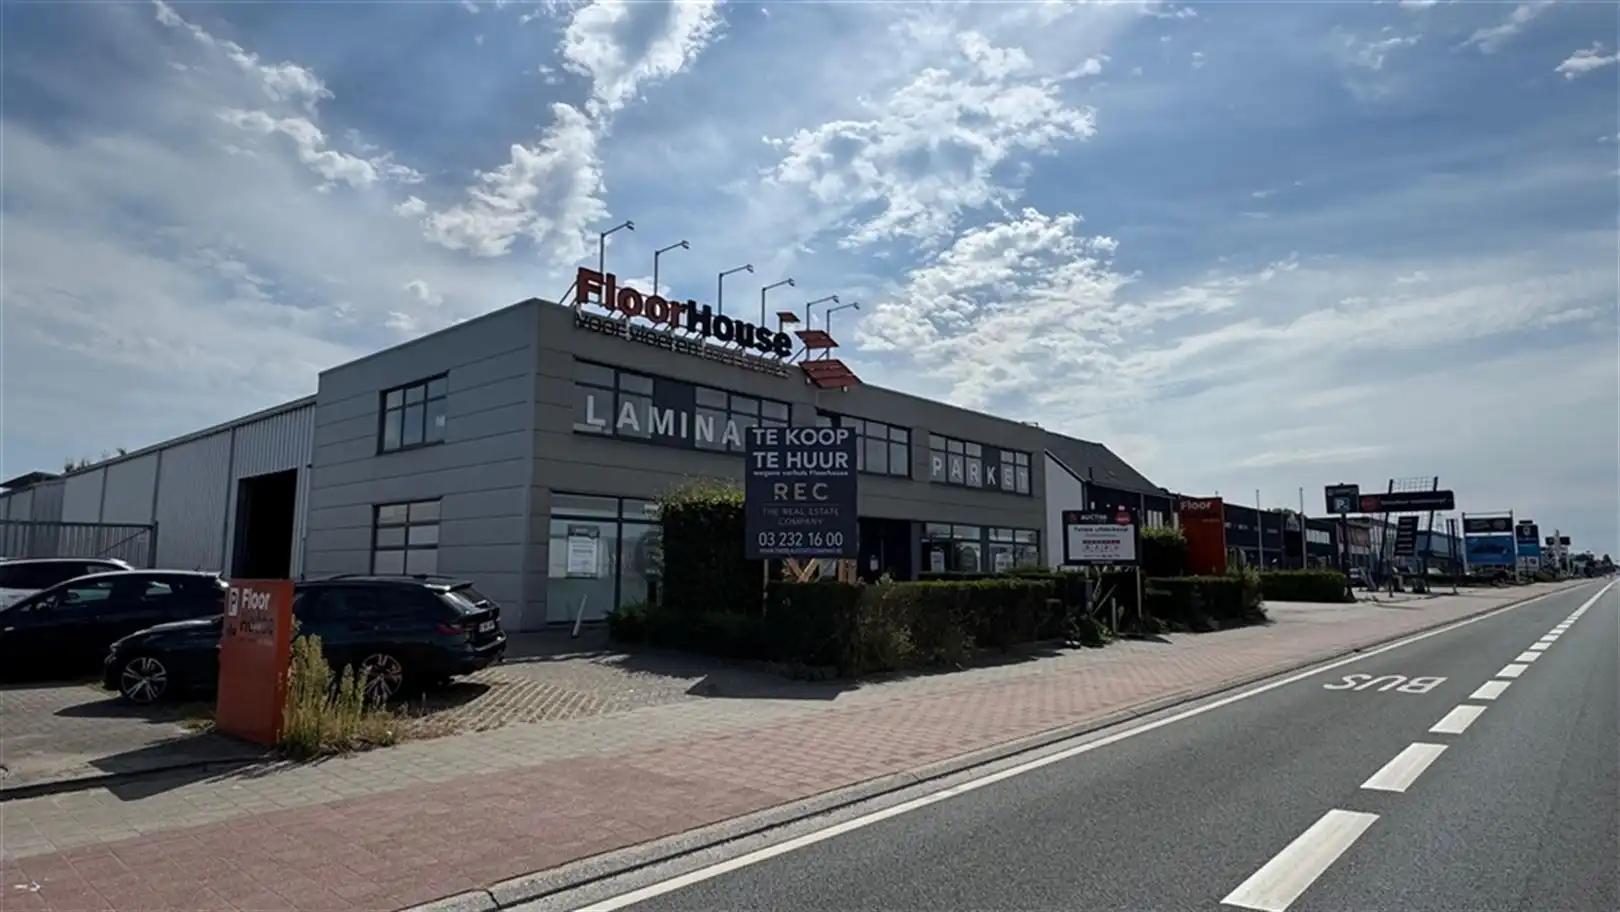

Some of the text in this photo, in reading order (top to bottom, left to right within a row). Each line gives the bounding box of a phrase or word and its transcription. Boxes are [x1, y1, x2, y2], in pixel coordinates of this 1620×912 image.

[752, 428, 849, 446] TE KOOP
[752, 451, 849, 469] TE HUUR
[773, 482, 829, 501] REC
[762, 507, 840, 517] THE REAL ESTATE
[1180, 501, 1213, 511] Floor
[778, 517, 824, 526] COMPANY
[758, 531, 844, 547] 03 232 16 00
[241, 587, 270, 611] Floor
[1323, 673, 1448, 693] BUS
